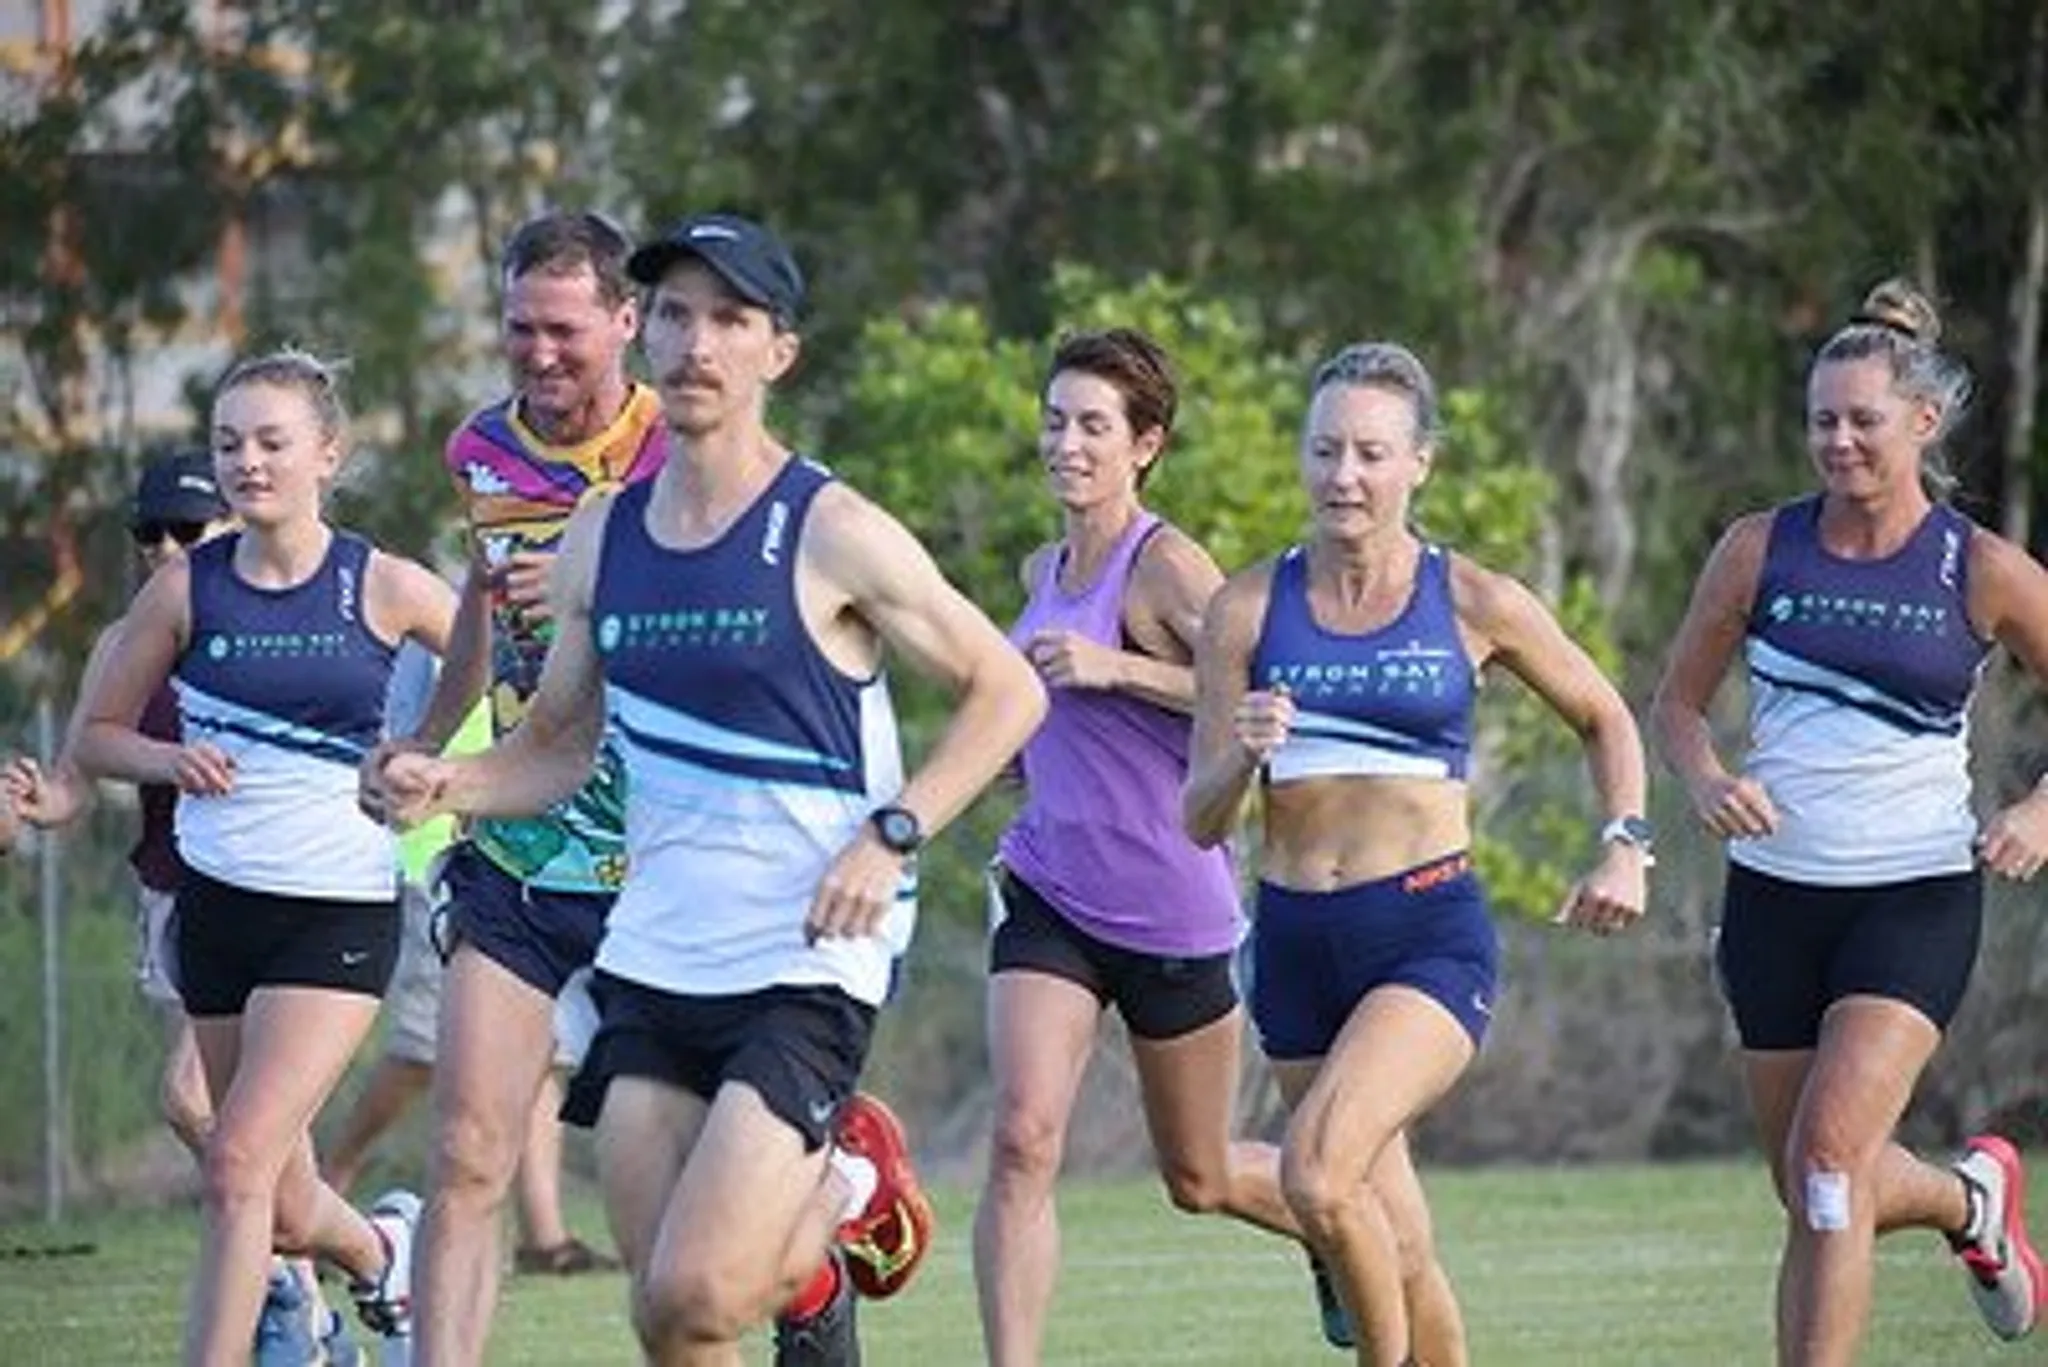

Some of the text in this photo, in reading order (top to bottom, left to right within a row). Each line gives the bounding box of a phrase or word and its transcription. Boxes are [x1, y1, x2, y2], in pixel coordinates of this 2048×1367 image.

[627, 608, 769, 633] BYRON BAY
[1268, 662, 1441, 683] BYRON BAY
